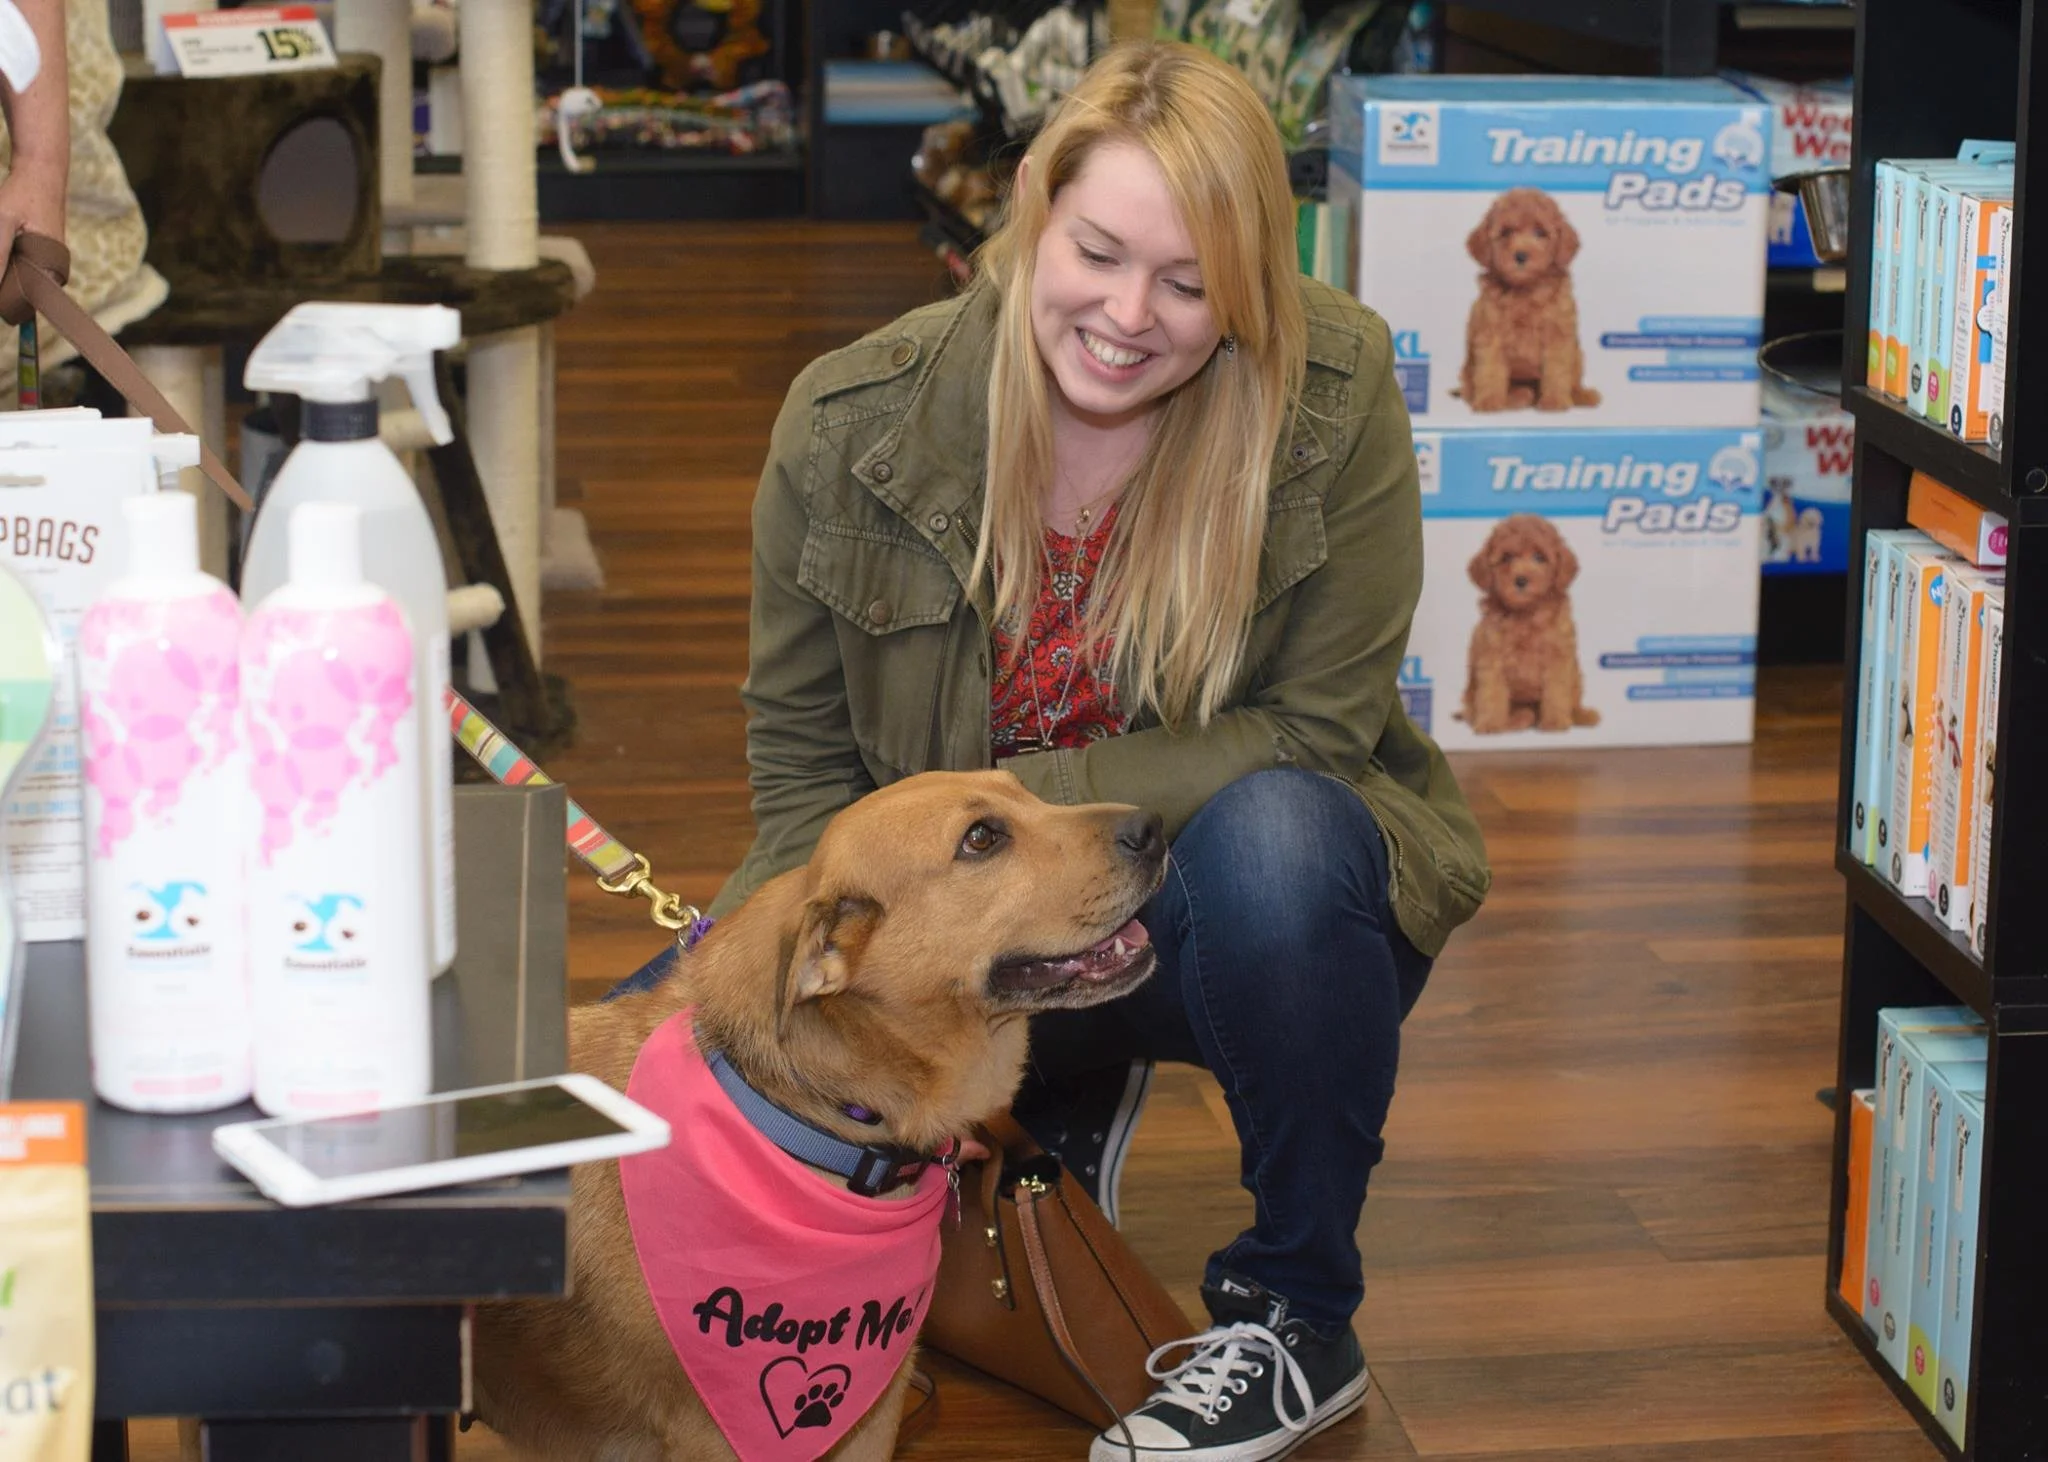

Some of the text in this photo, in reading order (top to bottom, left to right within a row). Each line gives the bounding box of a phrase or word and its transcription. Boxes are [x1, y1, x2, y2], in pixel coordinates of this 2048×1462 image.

[1488, 129, 1703, 173] Training
[1604, 172, 1746, 212] Pads
[1489, 456, 1698, 497] Training
[1602, 497, 1741, 534] Pads
[693, 1286, 851, 1353] Adopt
[2, 1368, 65, 1415] at
